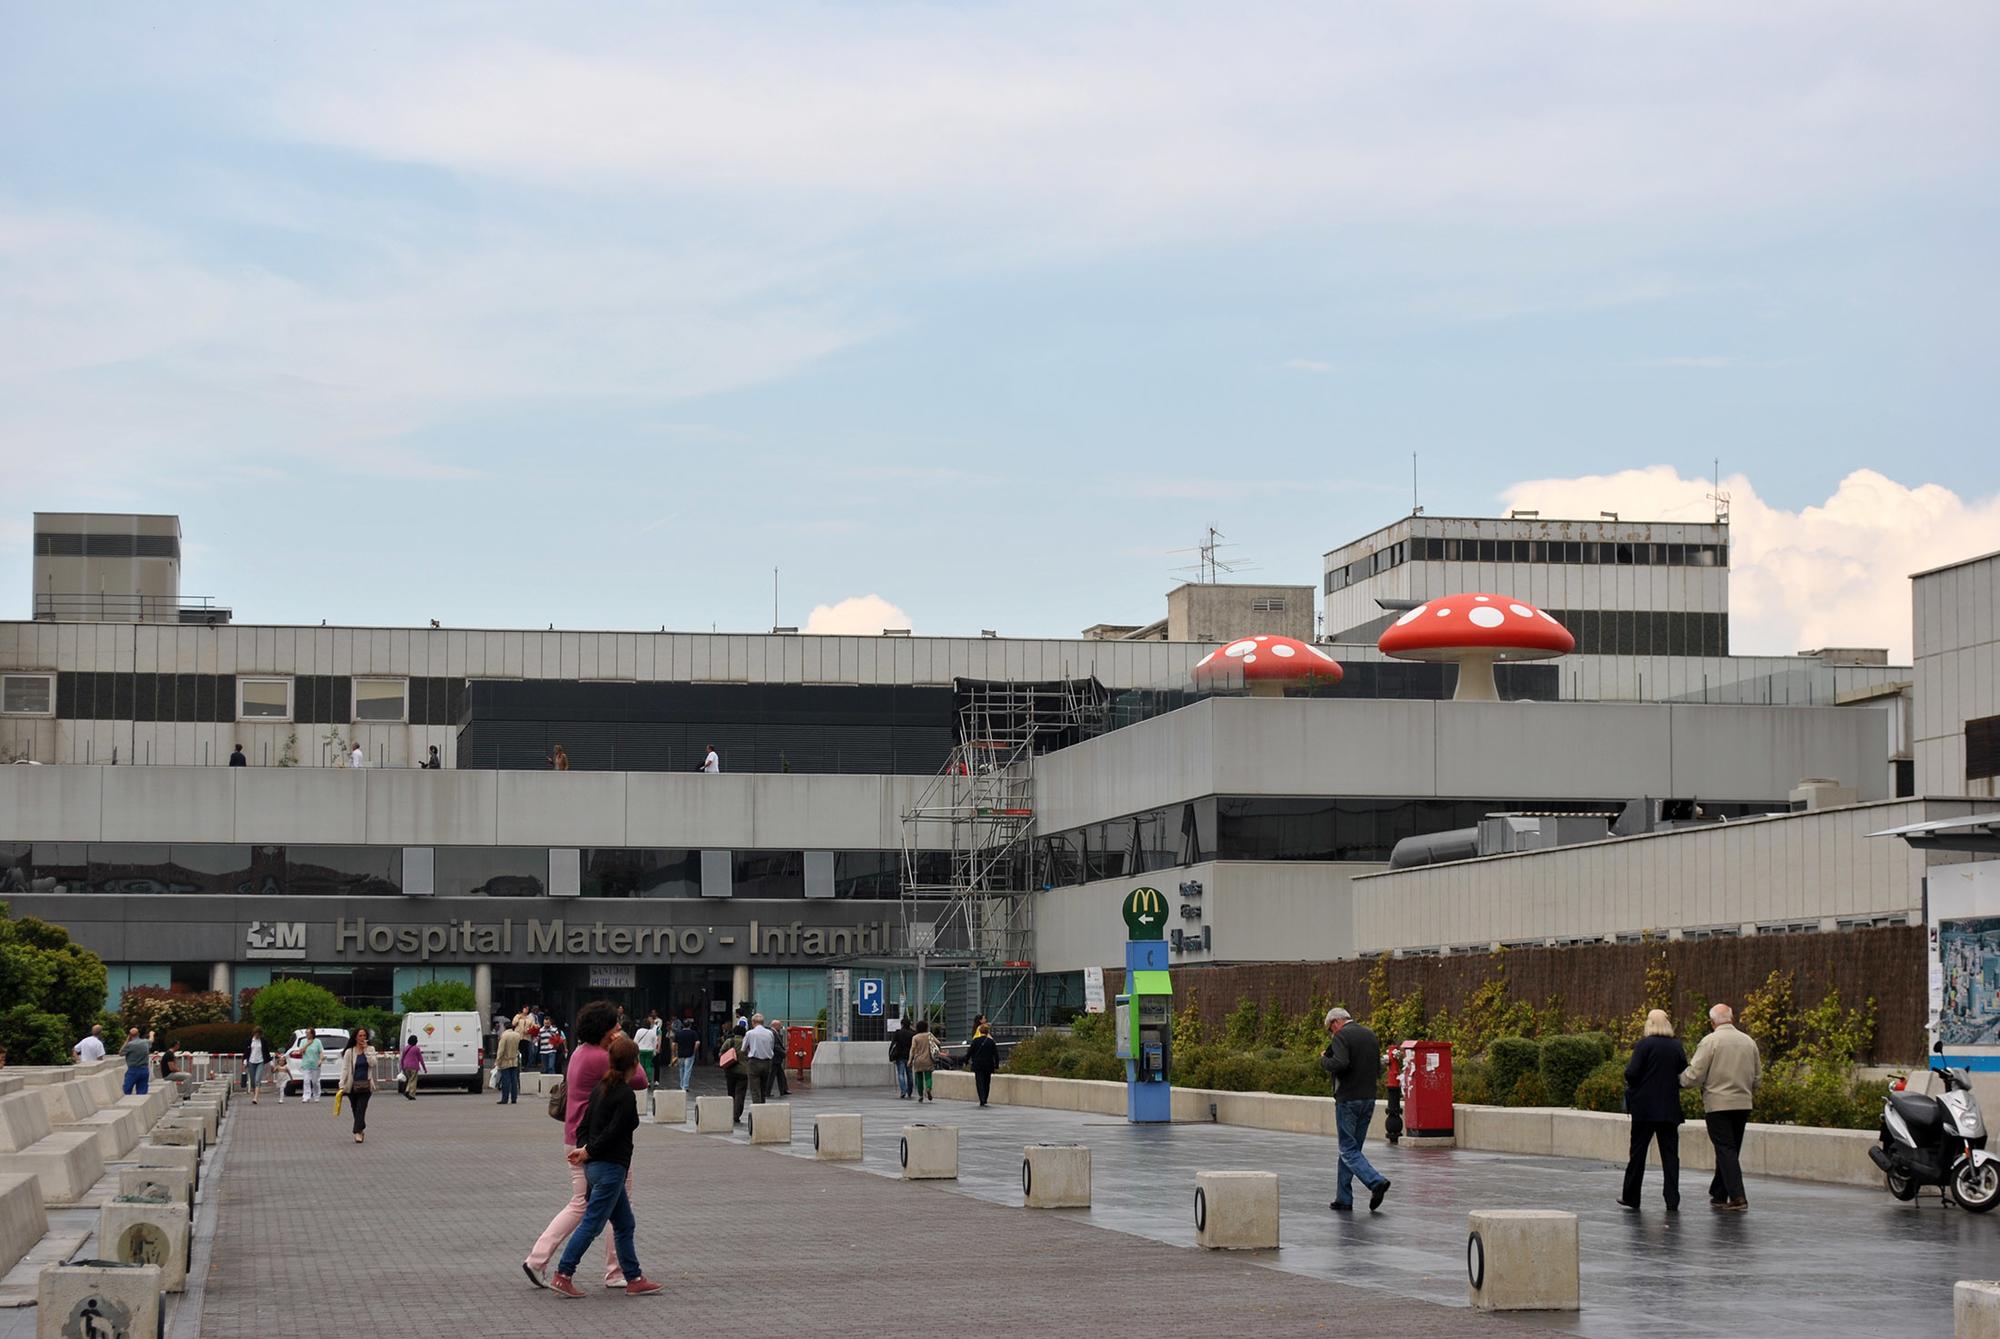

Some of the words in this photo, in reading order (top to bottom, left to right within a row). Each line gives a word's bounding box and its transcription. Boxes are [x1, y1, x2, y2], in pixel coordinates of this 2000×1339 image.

[335, 917, 511, 960] Hospital
[526, 918, 705, 954] Materno
[750, 920, 890, 955] Infantil
[863, 982, 878, 1000] P
